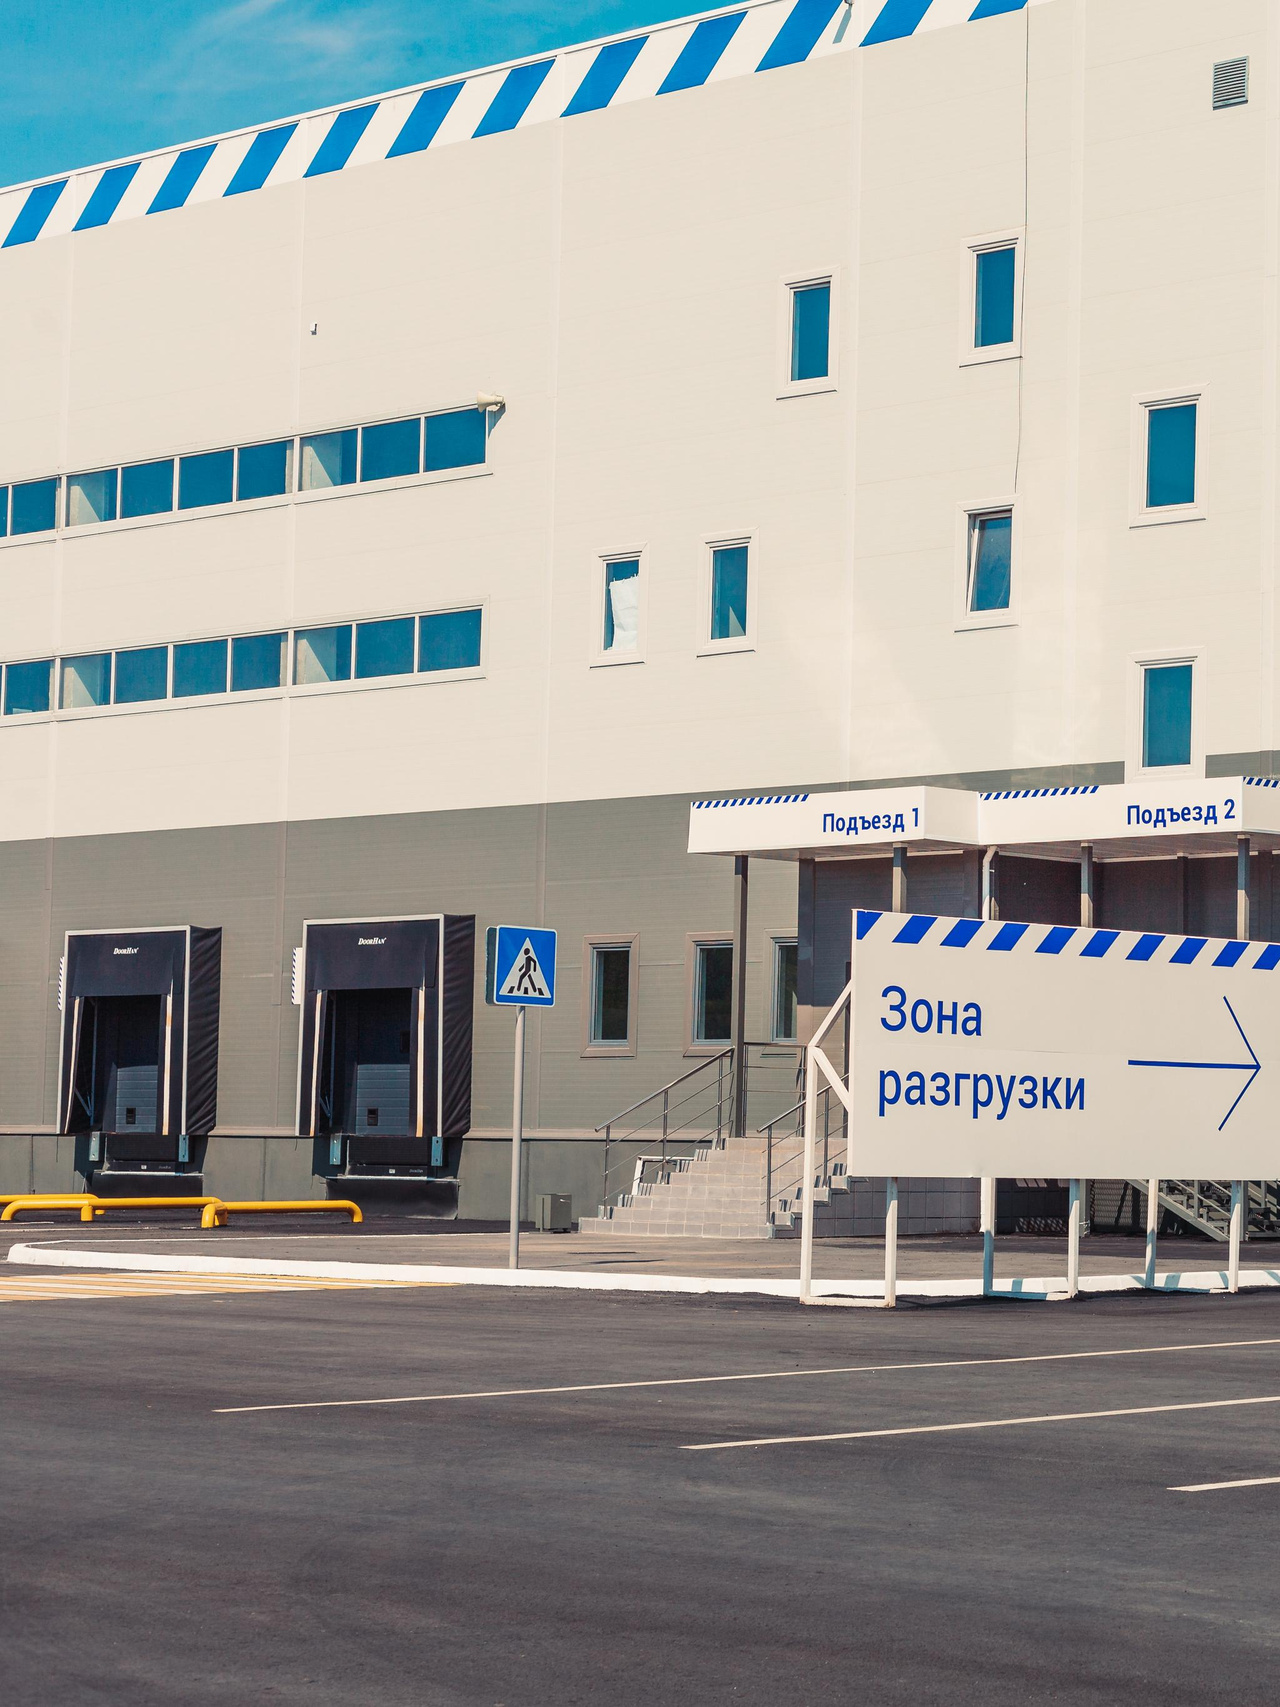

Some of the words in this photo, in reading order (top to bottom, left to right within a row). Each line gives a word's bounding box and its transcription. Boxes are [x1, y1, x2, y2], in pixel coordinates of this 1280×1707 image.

[823, 812, 905, 835] Подъезд
[912, 807, 919, 827] 1
[1127, 804, 1218, 828] Подъезд
[1224, 799, 1235, 820] 2
[881, 985, 982, 1036] Зона
[879, 1070, 1085, 1121] разгрузки
